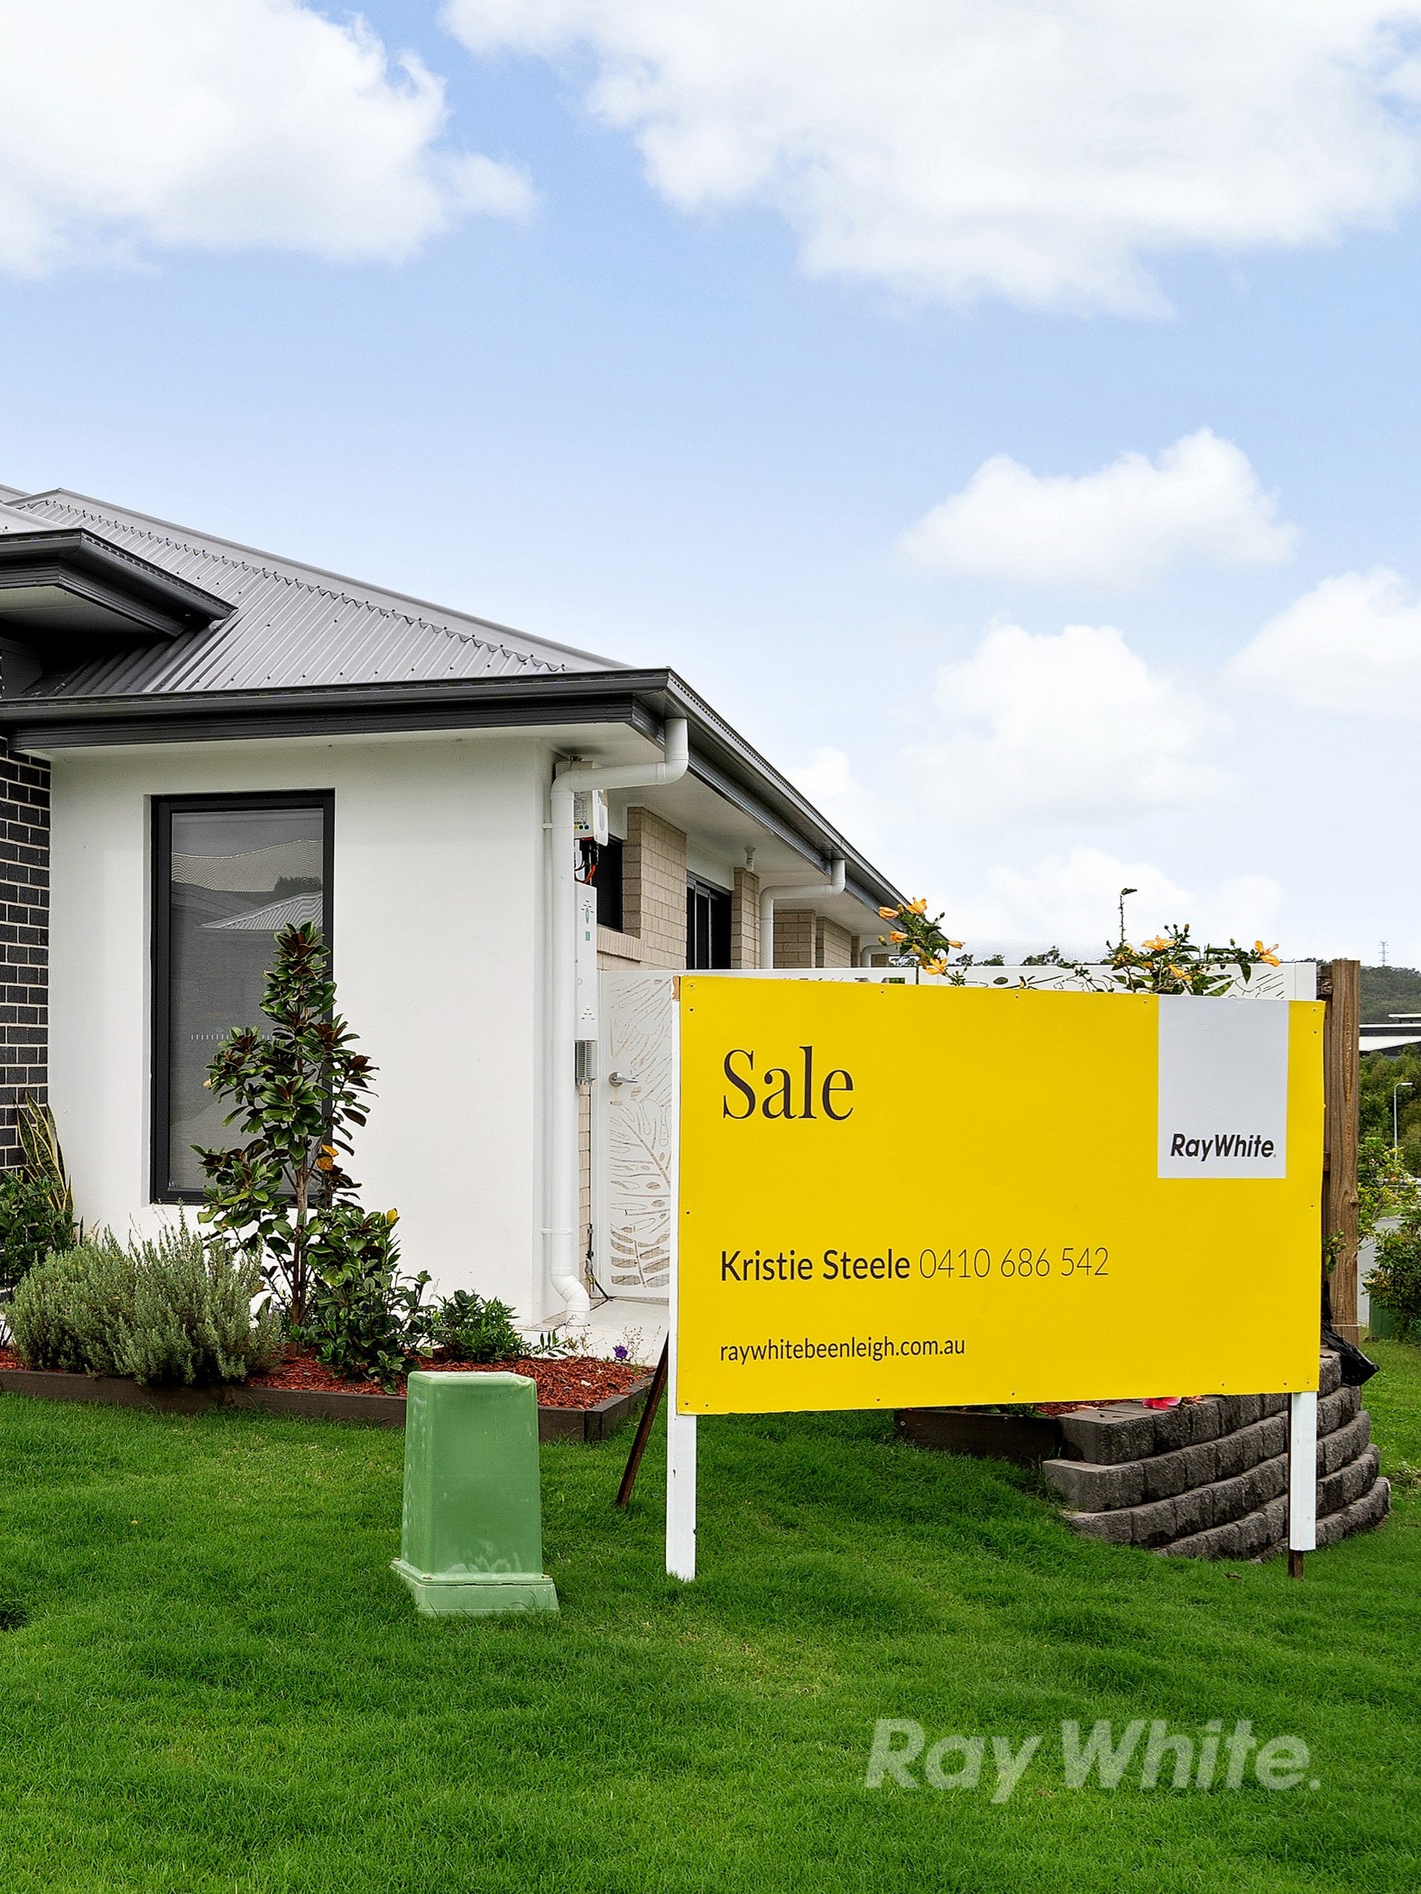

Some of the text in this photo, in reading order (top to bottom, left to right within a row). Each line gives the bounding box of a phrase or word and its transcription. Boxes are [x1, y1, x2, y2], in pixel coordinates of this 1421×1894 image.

[722, 1045, 855, 1121] Sale
[720, 1247, 1109, 1282] Kristie Steele 0410 686 542
[720, 1335, 966, 1365] raywhitebeenleigh.com.au
